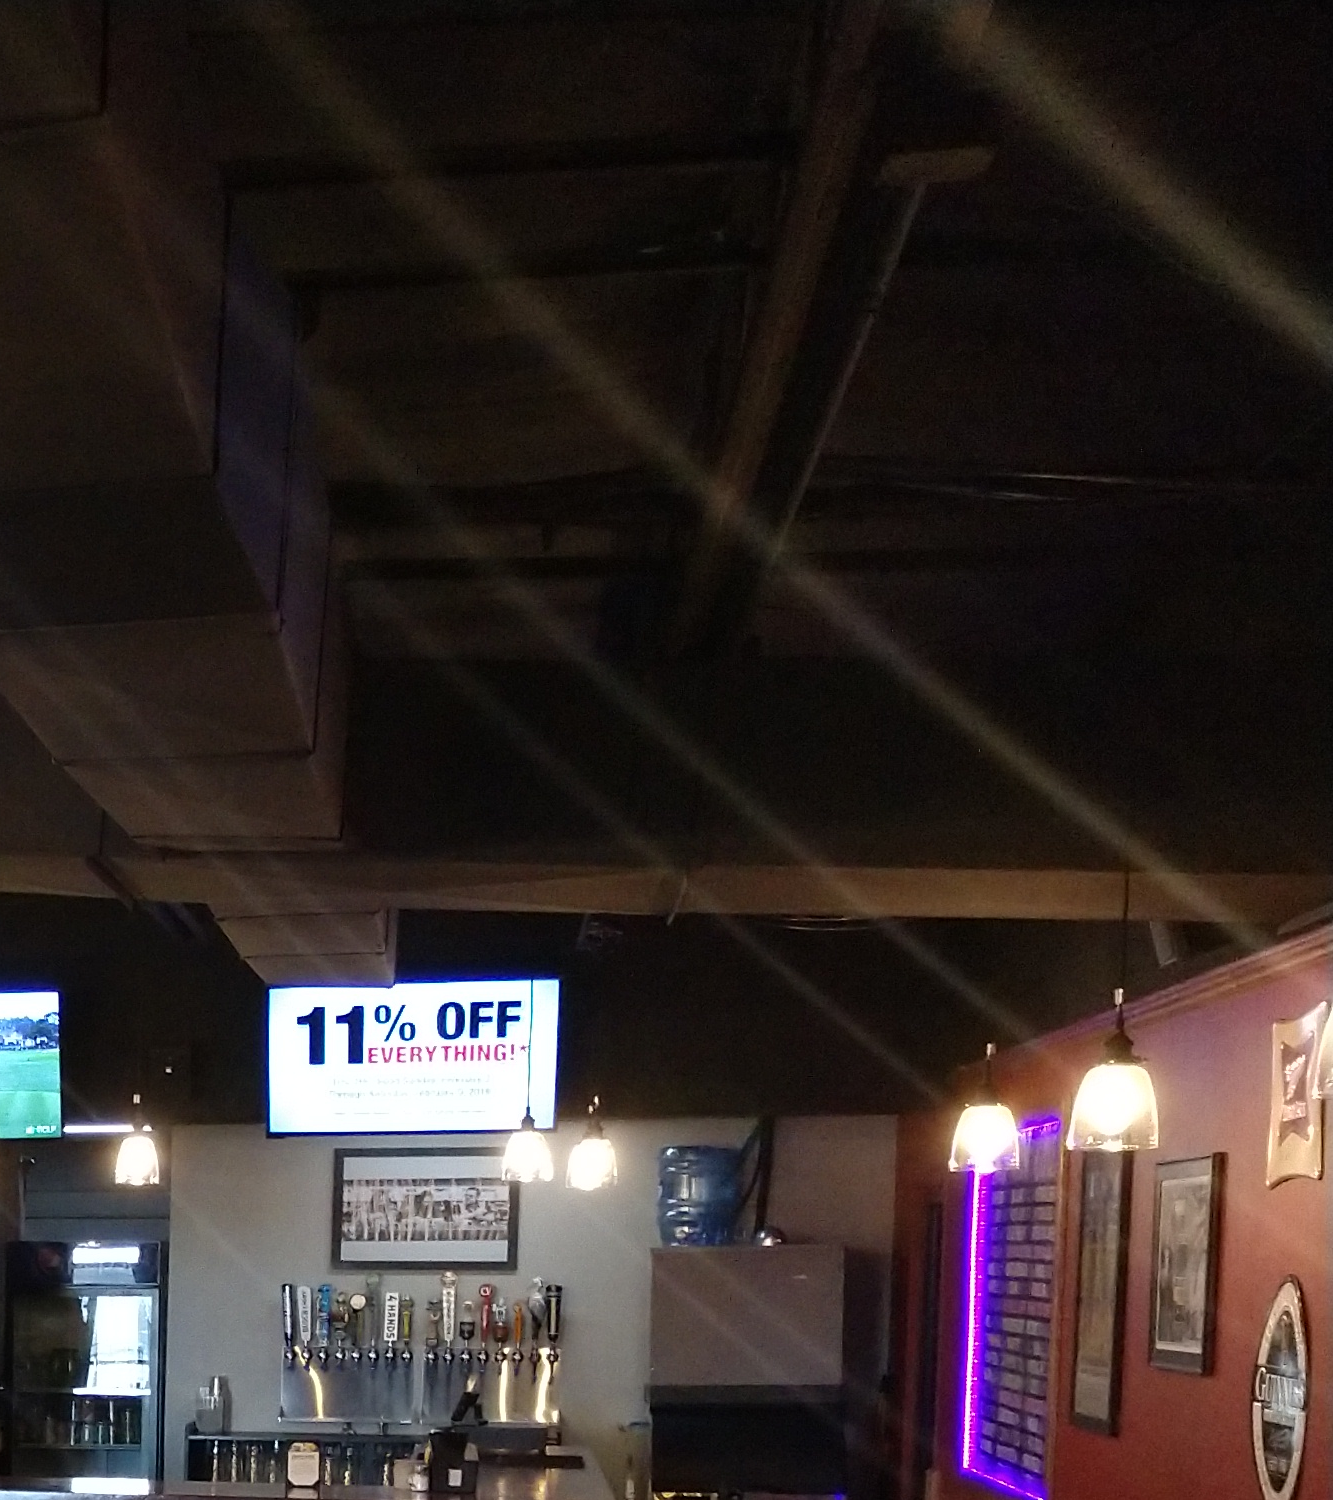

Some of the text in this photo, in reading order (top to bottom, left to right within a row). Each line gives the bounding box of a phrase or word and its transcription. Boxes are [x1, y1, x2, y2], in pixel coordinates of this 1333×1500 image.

[296, 1000, 522, 1065] 11% OFF
[385, 1294, 398, 1302] 4
[385, 1304, 397, 1340] HANDS
[1254, 1365, 1305, 1409] GUINN
